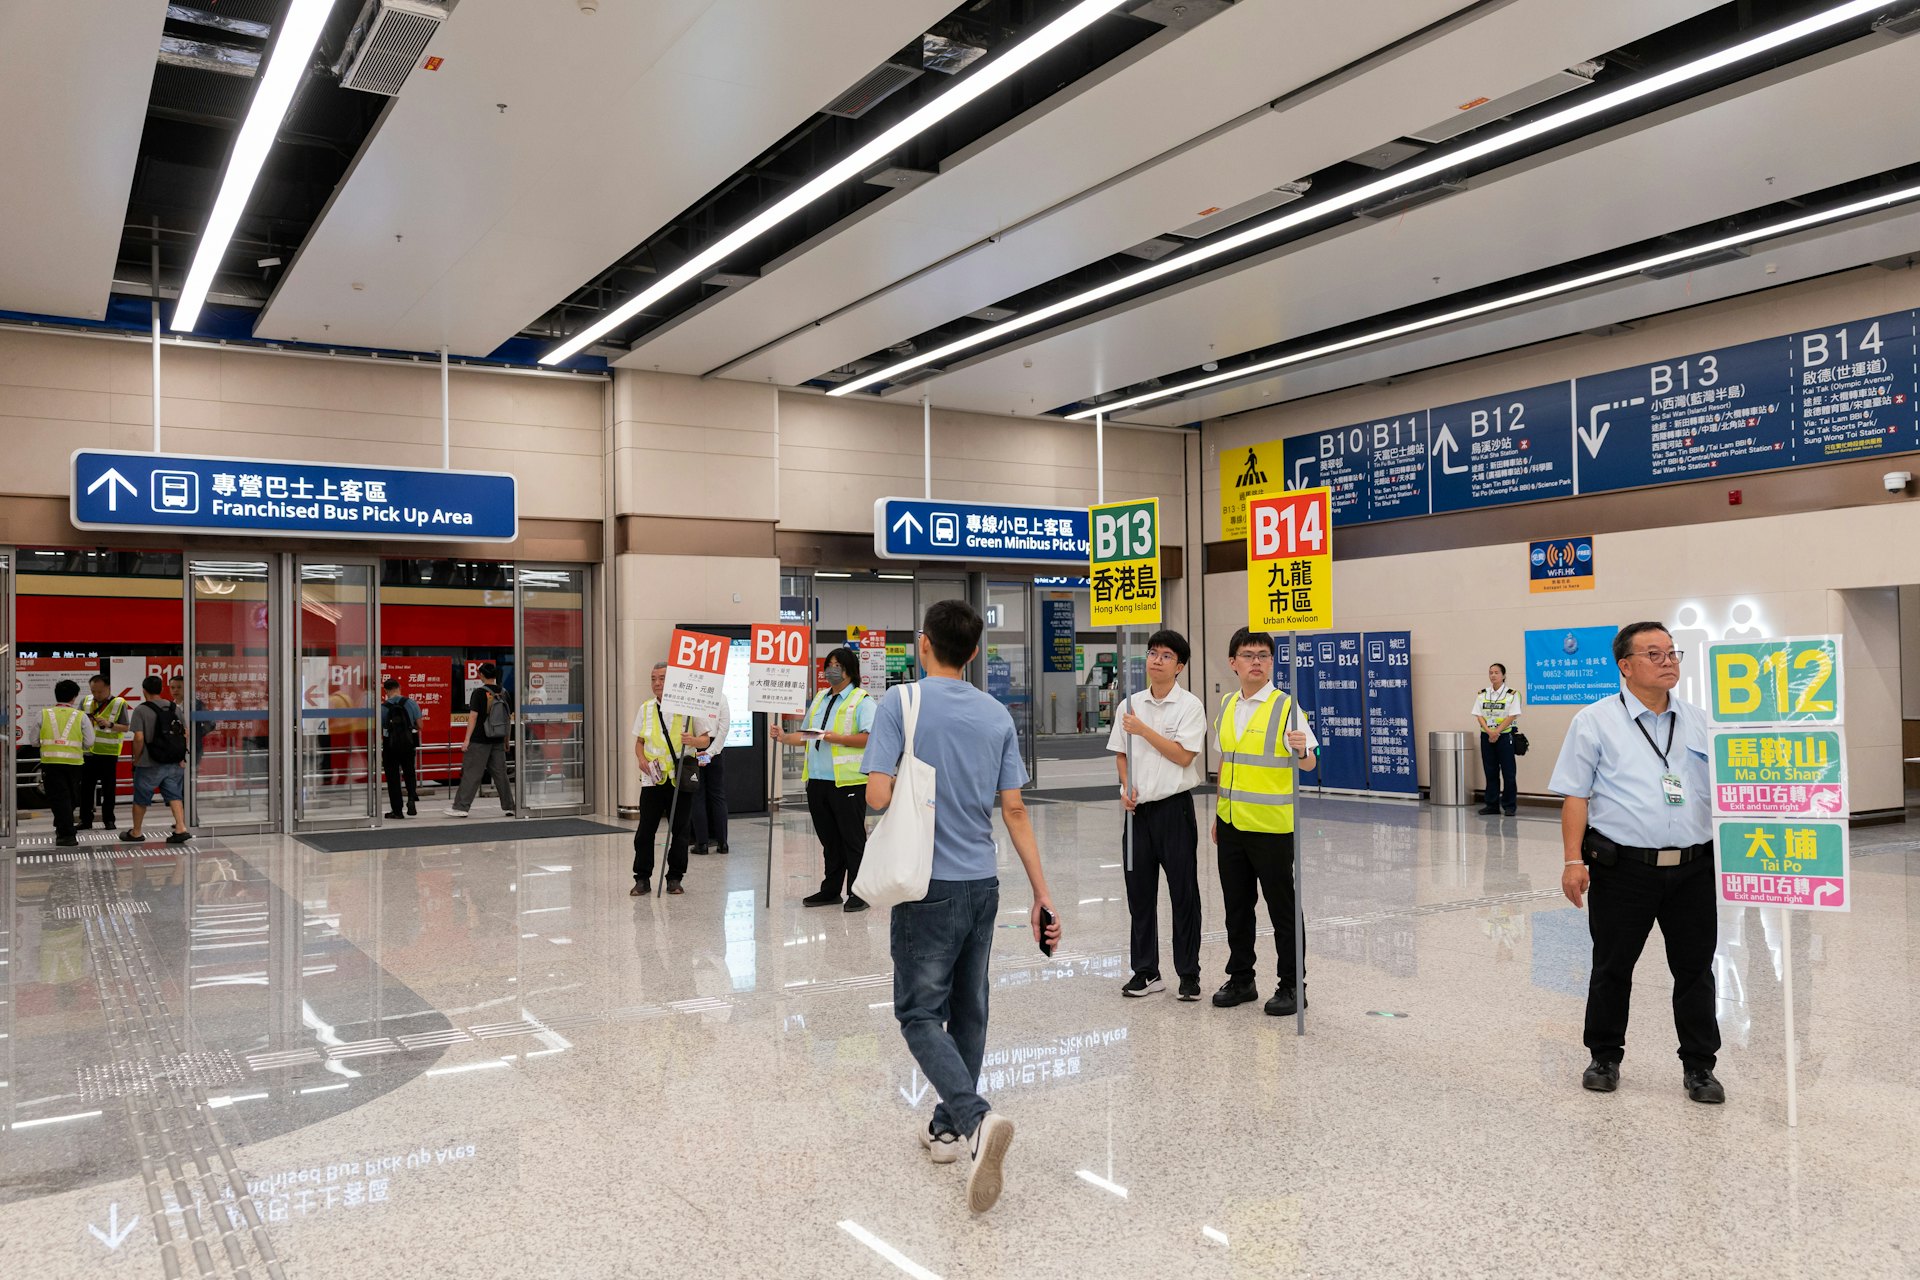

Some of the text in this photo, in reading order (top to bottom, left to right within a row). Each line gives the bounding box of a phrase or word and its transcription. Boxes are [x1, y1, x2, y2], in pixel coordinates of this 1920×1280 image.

[1802, 321, 1884, 368] B14
[1651, 355, 1719, 396] B13
[1802, 358, 1887, 386] 啟德(世運道)
[1803, 373, 1894, 395] Kai Tak (Olympic Avenue)
[1651, 384, 1746, 413] 小西灣(藍灣半島)
[1471, 402, 1525, 438] B12
[1662, 412, 1672, 420] Sai
[1673, 410, 1686, 418] Wan
[1687, 406, 1707, 416] (Island
[1708, 402, 1732, 412] Resort)
[1804, 412, 1862, 428] Via: Tai Lam BBI
[1373, 417, 1416, 449] B11
[1804, 426, 1886, 445] Sung Wong Toi Station
[1817, 426, 1830, 434] Tak
[1832, 421, 1856, 433] Sports
[1857, 419, 1877, 428] Park/
[1320, 428, 1363, 459] B10
[1665, 450, 1677, 458] San
[1689, 446, 1700, 454] BBI
[1720, 441, 1734, 449] Lam
[1735, 439, 1747, 447] BBI
[1500, 449, 1519, 458] Station
[1652, 459, 1667, 467] WHT
[1668, 457, 1679, 465] BBI
[1730, 447, 1747, 457] Point
[1749, 444, 1773, 454] Station
[1663, 466, 1677, 474] Wan
[1688, 461, 1710, 471] Station
[211, 472, 388, 503] 專營巴士上客區
[1509, 485, 1519, 493] Fuk
[212, 500, 473, 528] Franchised Bus Pick Up Area
[966, 513, 1074, 537] 專線小巴上客區
[1095, 509, 1153, 559] B13
[1255, 500, 1324, 556] B14
[966, 535, 1002, 549] Green
[1004, 536, 1050, 550] Minibus
[1052, 538, 1076, 552] Pick
[1093, 564, 1157, 602] 香港島
[1268, 560, 1313, 588] 九龍
[1094, 601, 1157, 614] Hong Kong Island
[1268, 588, 1313, 614] 市區
[1263, 614, 1318, 625] Urban Kowloon
[677, 635, 723, 672] B11
[757, 629, 803, 664] B10
[1340, 639, 1356, 650] 城巴
[1389, 639, 1405, 649] 城巴
[1296, 655, 1315, 668] B15
[1338, 654, 1359, 666] B14
[1388, 653, 1409, 666] B13
[331, 665, 361, 686] B11
[1715, 648, 1834, 715] B12
[1546, 683, 1567, 691] require
[1567, 682, 1586, 690] police
[1532, 693, 1562, 702] please dial
[318, 720, 327, 733] 4
[1727, 736, 1827, 768] 馬鞍山
[1735, 767, 1823, 781] Ma On Shan
[1721, 786, 1807, 804] 出門口右轉
[1730, 802, 1799, 812] Exit and turn right
[1744, 827, 1817, 860] 大埔
[1760, 858, 1802, 873] Tai Po
[1726, 876, 1810, 896] 出門口右轉
[1734, 892, 1803, 904] Exit and turn right
